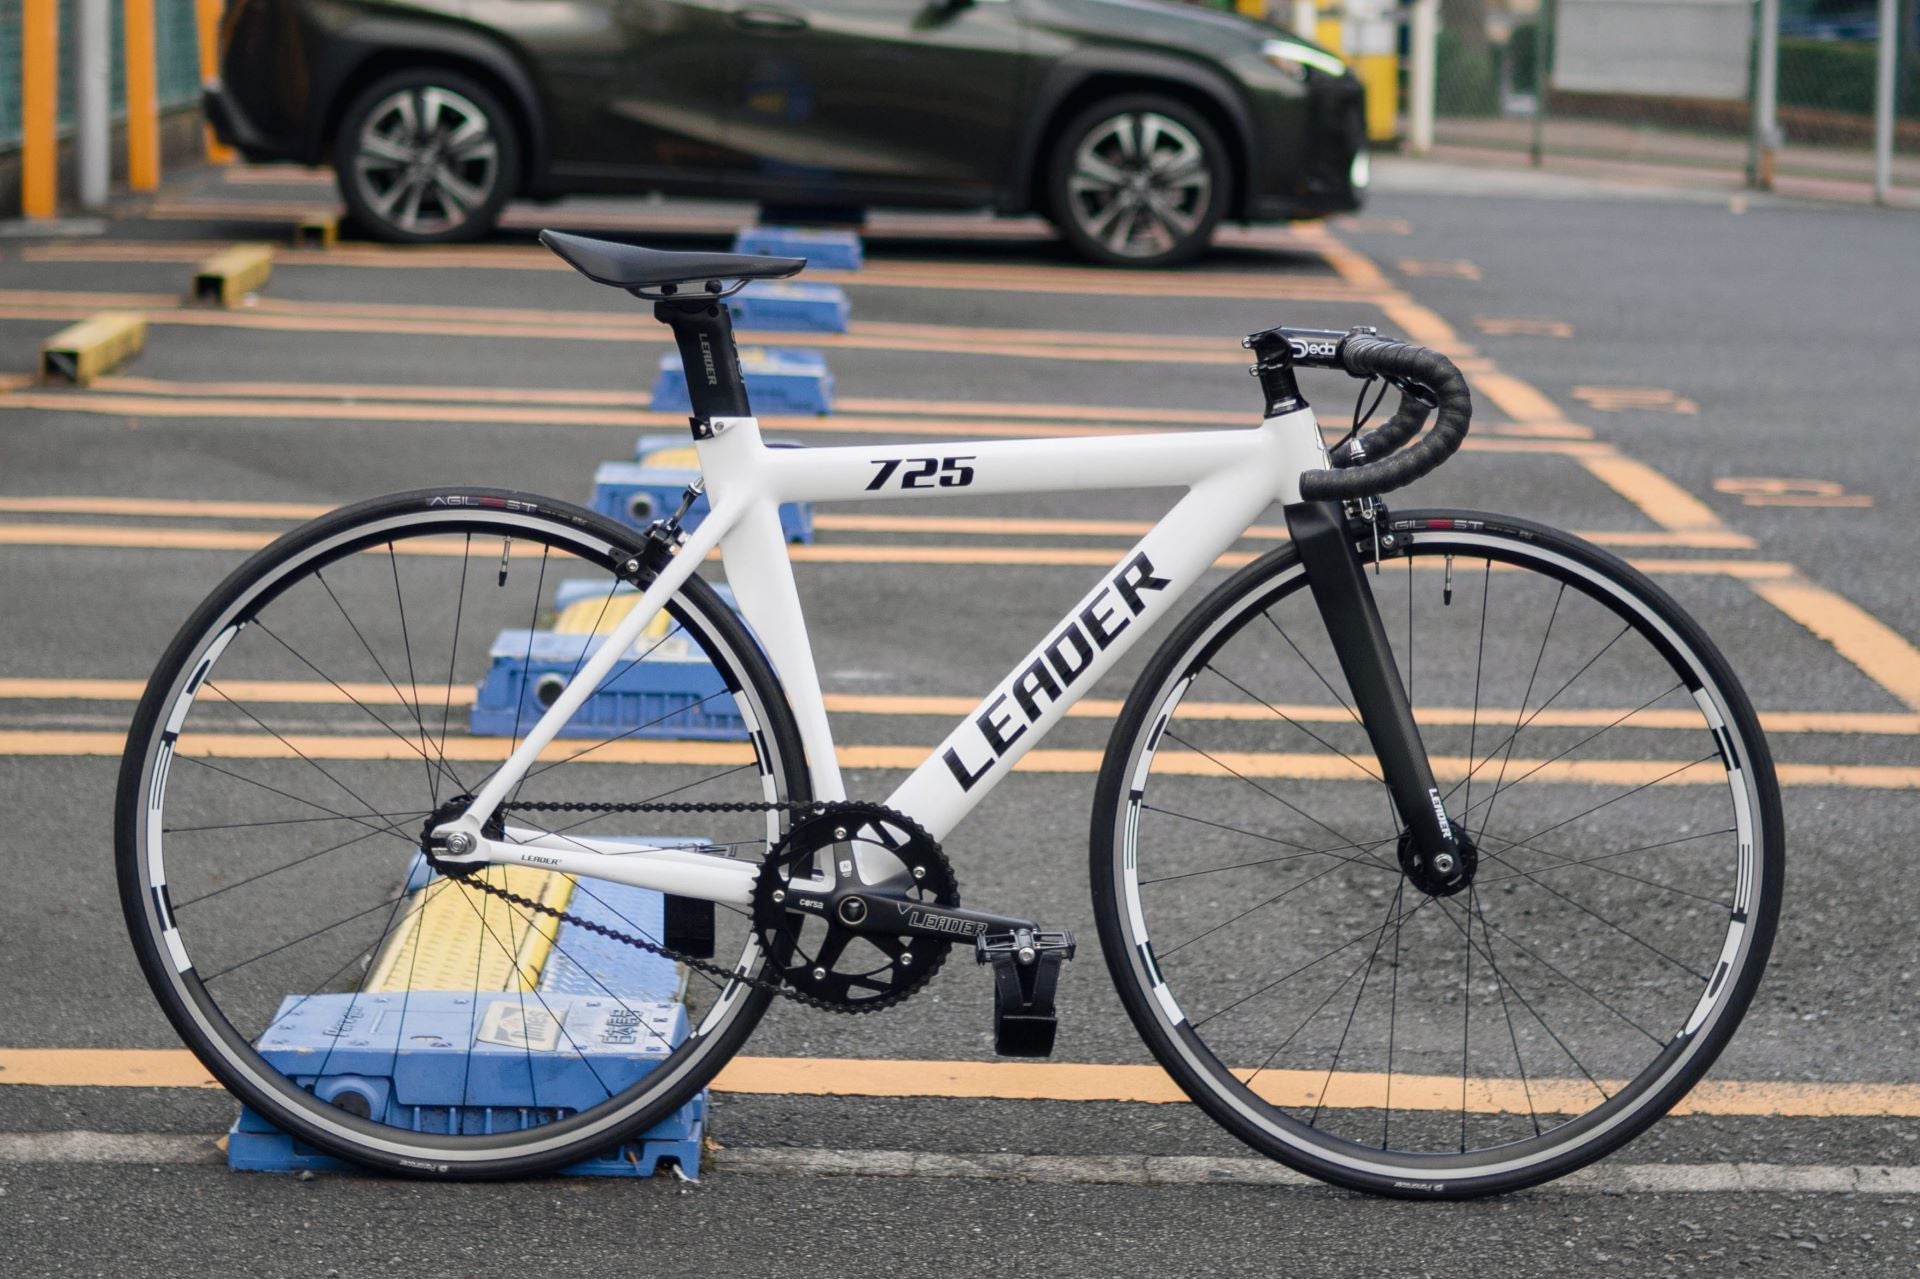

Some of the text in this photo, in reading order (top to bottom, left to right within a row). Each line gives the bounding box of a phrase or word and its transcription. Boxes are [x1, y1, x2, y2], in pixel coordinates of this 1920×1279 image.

[699, 333, 717, 385] LEADER
[1288, 338, 1336, 358] Deda
[864, 456, 976, 491] 725
[942, 551, 1172, 792] LEADER
[1428, 788, 1452, 839] LEADER
[521, 854, 560, 866] LEADER
[799, 898, 824, 910] corsa
[909, 912, 988, 937] LEADER
